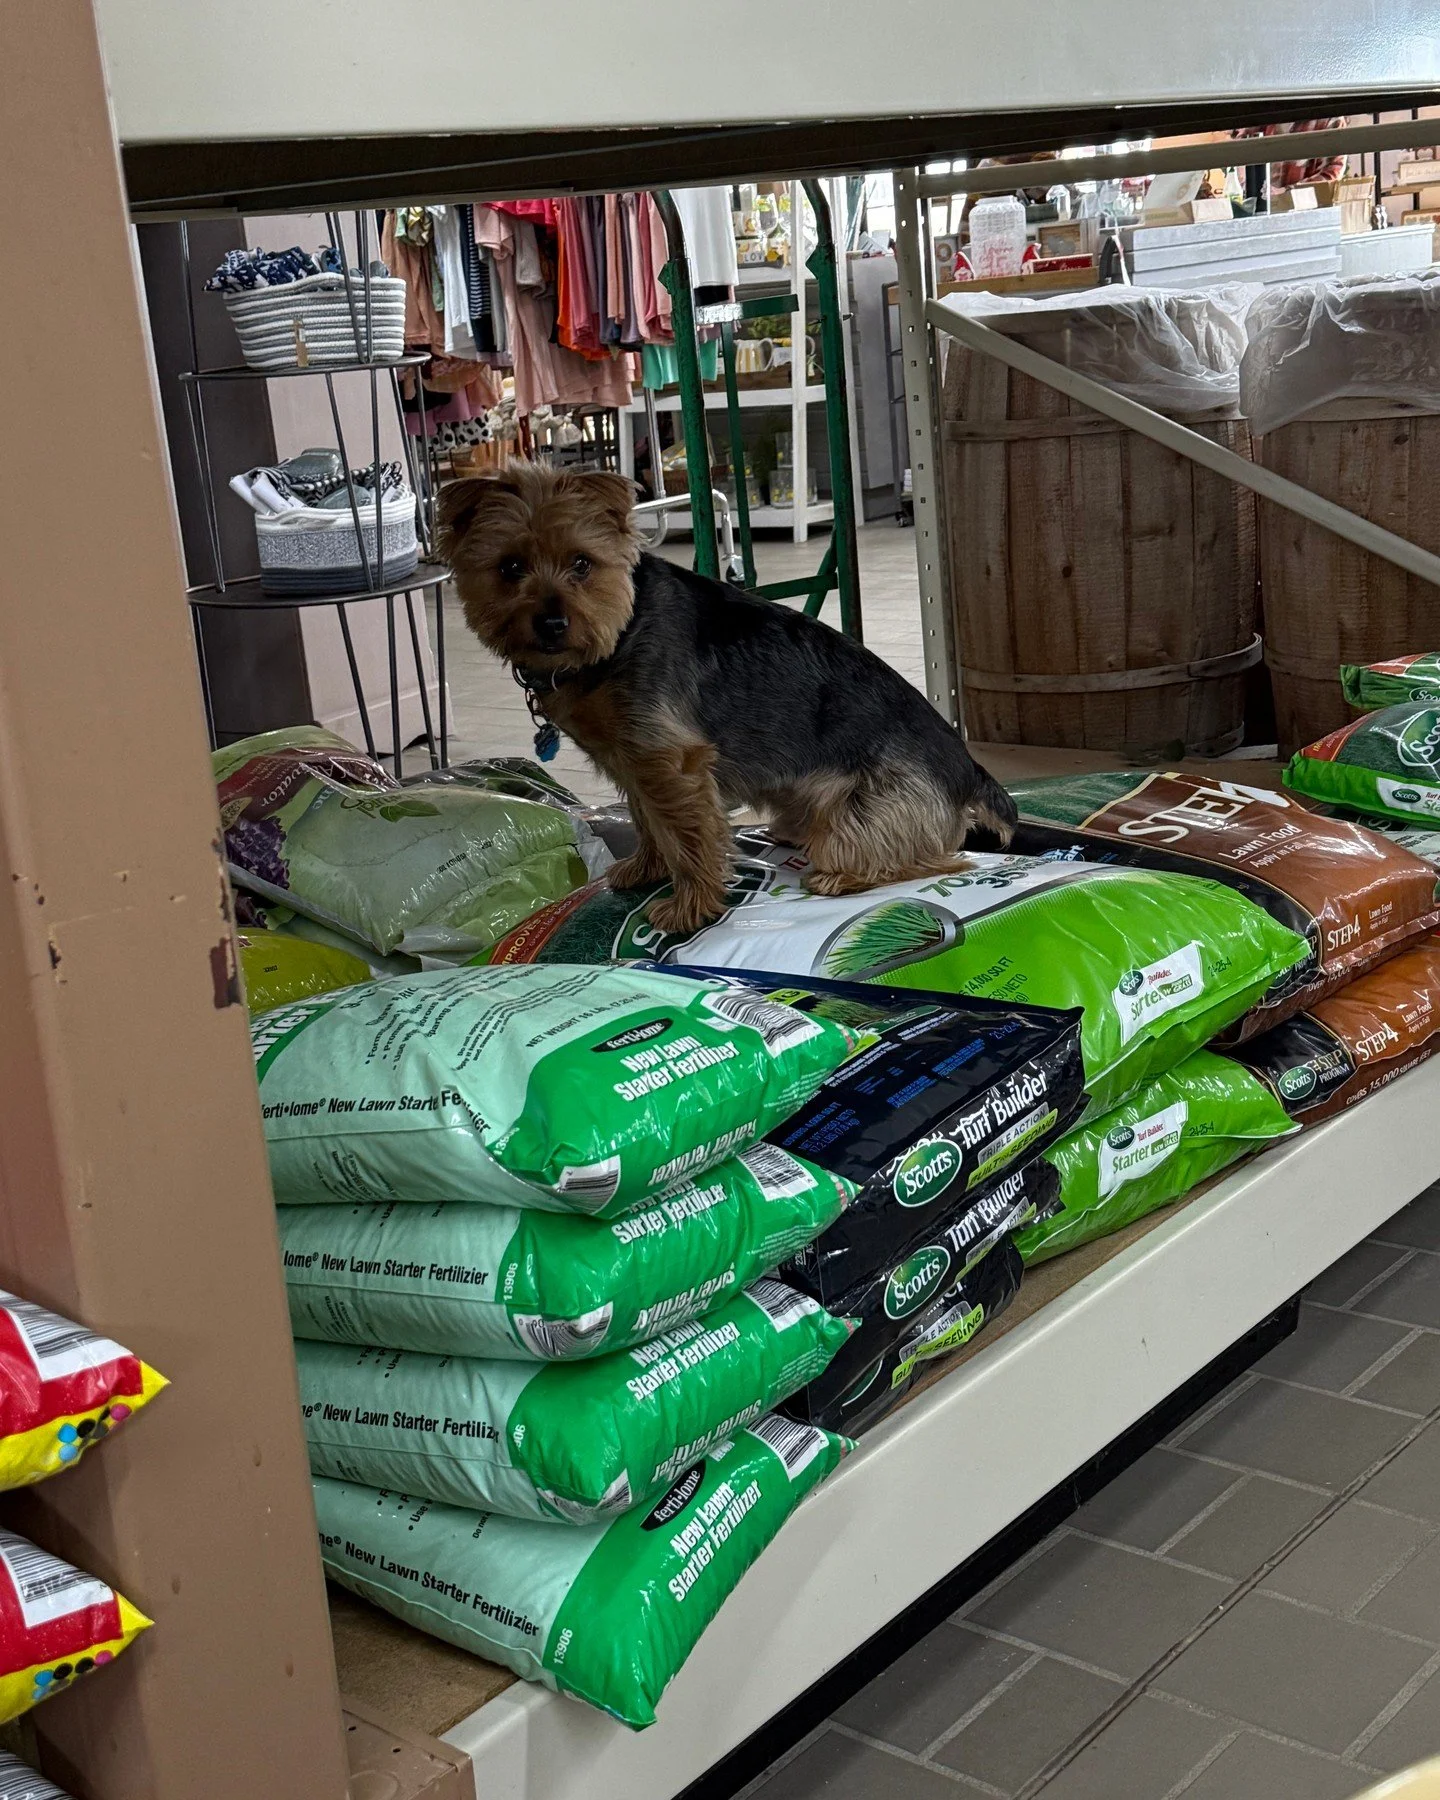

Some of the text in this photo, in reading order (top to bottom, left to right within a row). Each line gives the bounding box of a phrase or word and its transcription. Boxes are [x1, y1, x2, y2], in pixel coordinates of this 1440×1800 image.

[1394, 790, 1419, 801] Scotts
[1218, 823, 1303, 860] Lawn Food
[1249, 853, 1281, 868] Apply
[1327, 913, 1362, 952] STEP 4
[998, 955, 1014, 968] FT
[1402, 1002, 1432, 1024] Lawn Food
[526, 1034, 547, 1048] NET
[543, 1017, 581, 1037] WEIGHT
[1356, 1022, 1399, 1061] STEP 4
[613, 1040, 740, 1102] Starter Fertilizer
[620, 1035, 702, 1073] New Lawn
[1284, 1071, 1312, 1095] Scotts
[1346, 1088, 1367, 1105] COVERS
[327, 1098, 357, 1113] New
[358, 1097, 396, 1112] Lawn
[951, 1104, 992, 1150] Turf
[991, 1069, 1049, 1127] Builder
[980, 1109, 1046, 1160] TRIPLE ACTION
[1109, 1127, 1132, 1147] Scotts
[902, 1148, 953, 1199] Scotts
[1112, 1144, 1150, 1174] Starter
[321, 1252, 347, 1271] New
[350, 1255, 381, 1276] Lawn
[383, 1258, 425, 1281] Starter
[428, 1261, 490, 1287] Fertilizier
[503, 1262, 519, 1301] 13906
[894, 1256, 941, 1310] Scotts
[628, 1319, 706, 1369] New Lawn
[933, 1310, 982, 1352] SEEDING
[626, 1356, 683, 1402] Starter
[673, 1321, 742, 1372] Fertilizer
[323, 1404, 352, 1423] New
[354, 1406, 389, 1427] Lawn
[392, 1411, 440, 1433] Starter
[410, 1503, 430, 1523] Use
[472, 1525, 483, 1539] Do
[669, 1481, 736, 1559] New Lawn
[667, 1478, 763, 1602] Starter Fertilizer
[344, 1540, 540, 1637] New Lawn Starter Fertilizier
[553, 1627, 574, 1665] 13906
